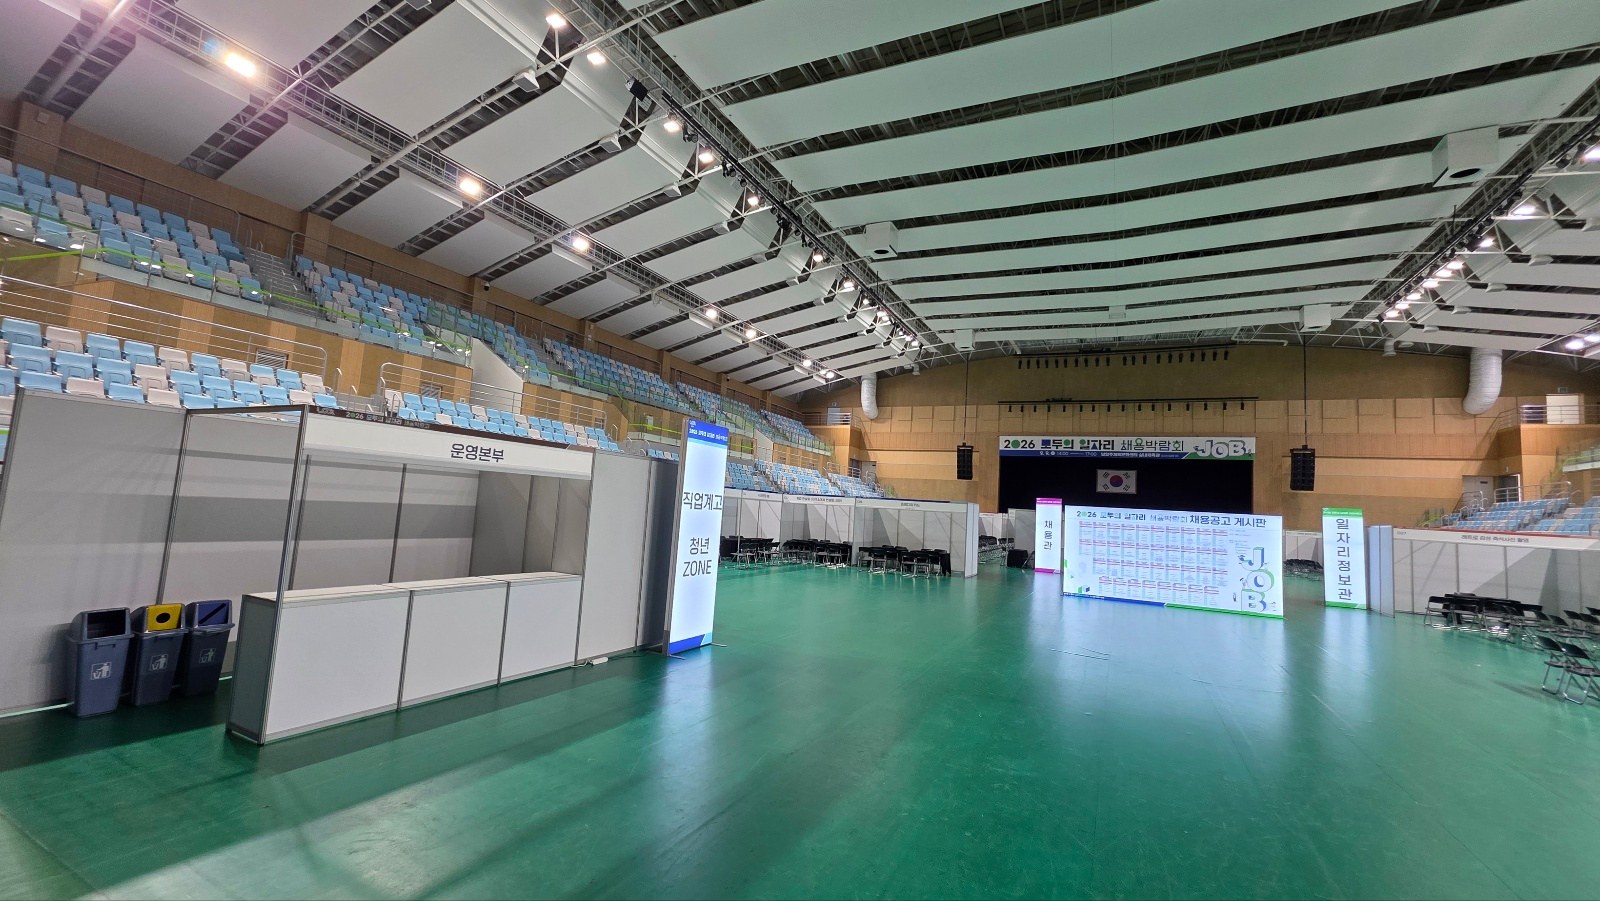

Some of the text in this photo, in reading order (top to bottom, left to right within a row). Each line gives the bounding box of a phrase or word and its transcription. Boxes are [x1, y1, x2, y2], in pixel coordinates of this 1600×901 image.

[451, 443, 505, 463] 운영본부
[1003, 437, 1184, 452] 2026 모두의 일자리 채용박람회
[1195, 439, 1246, 459] JOB
[682, 492, 723, 510] 직업계고
[1189, 514, 1232, 526] 채용공고
[1233, 517, 1267, 528] 게시판
[1043, 520, 1053, 551] 채용관
[689, 537, 710, 555] 청년
[682, 560, 712, 577] ZONE
[1336, 518, 1353, 601] 일자리정보관
